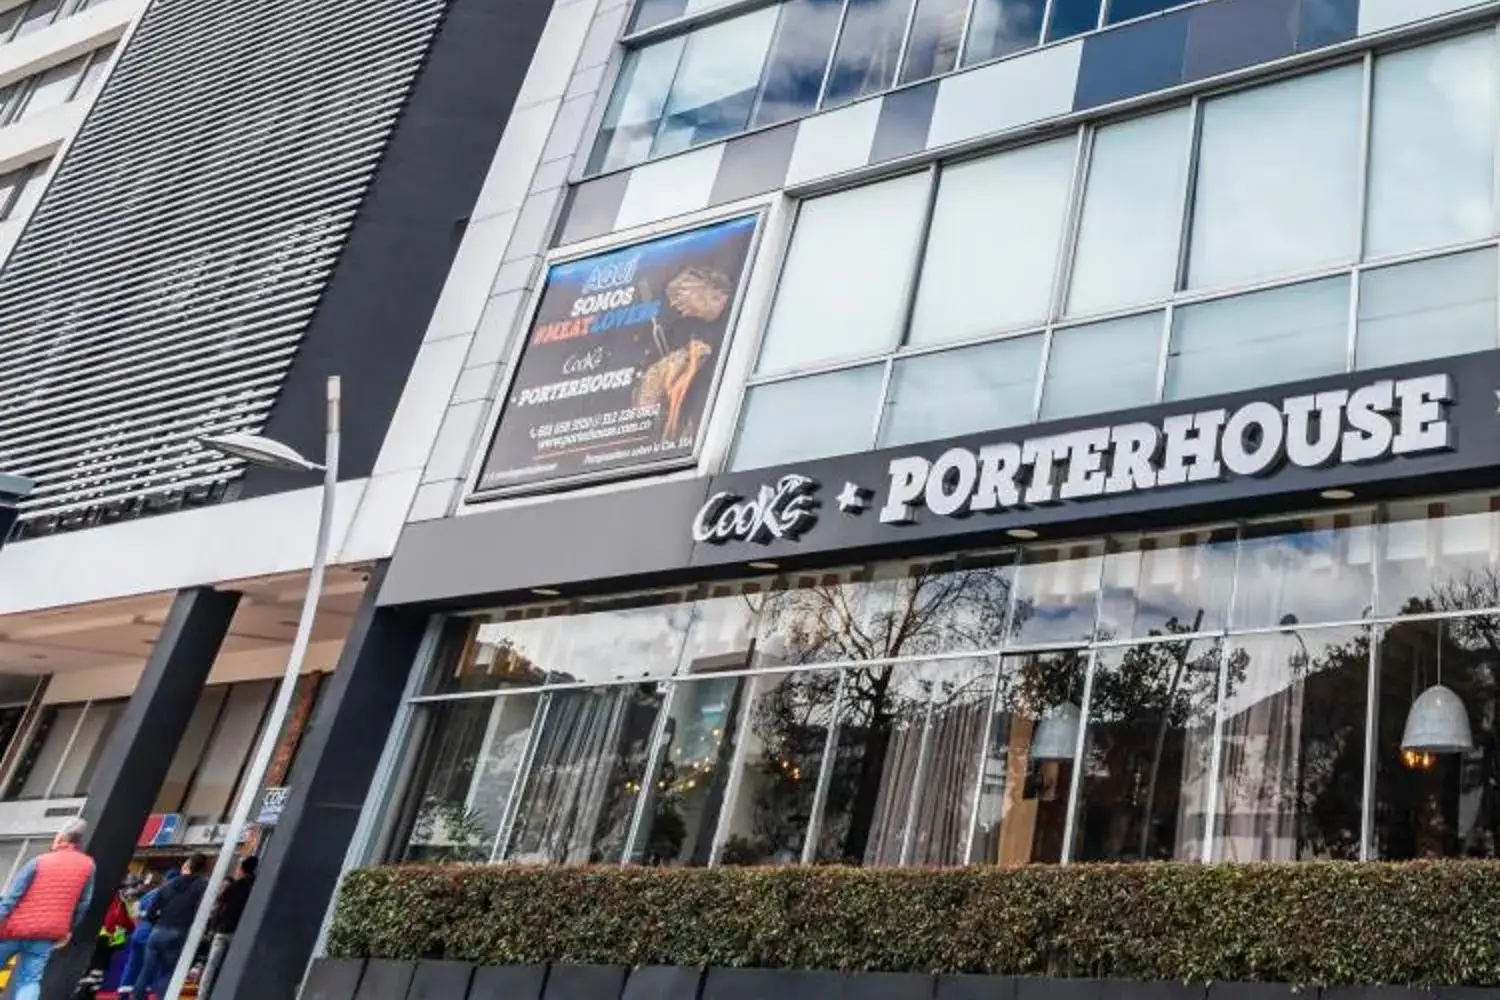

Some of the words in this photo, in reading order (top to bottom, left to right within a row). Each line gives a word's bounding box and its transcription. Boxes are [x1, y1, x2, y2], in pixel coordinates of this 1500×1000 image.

[571, 286, 634, 316] SOMOS
[517, 367, 635, 406] PORTERHOUSE
[879, 374, 1453, 523] PORTERHOUSE
